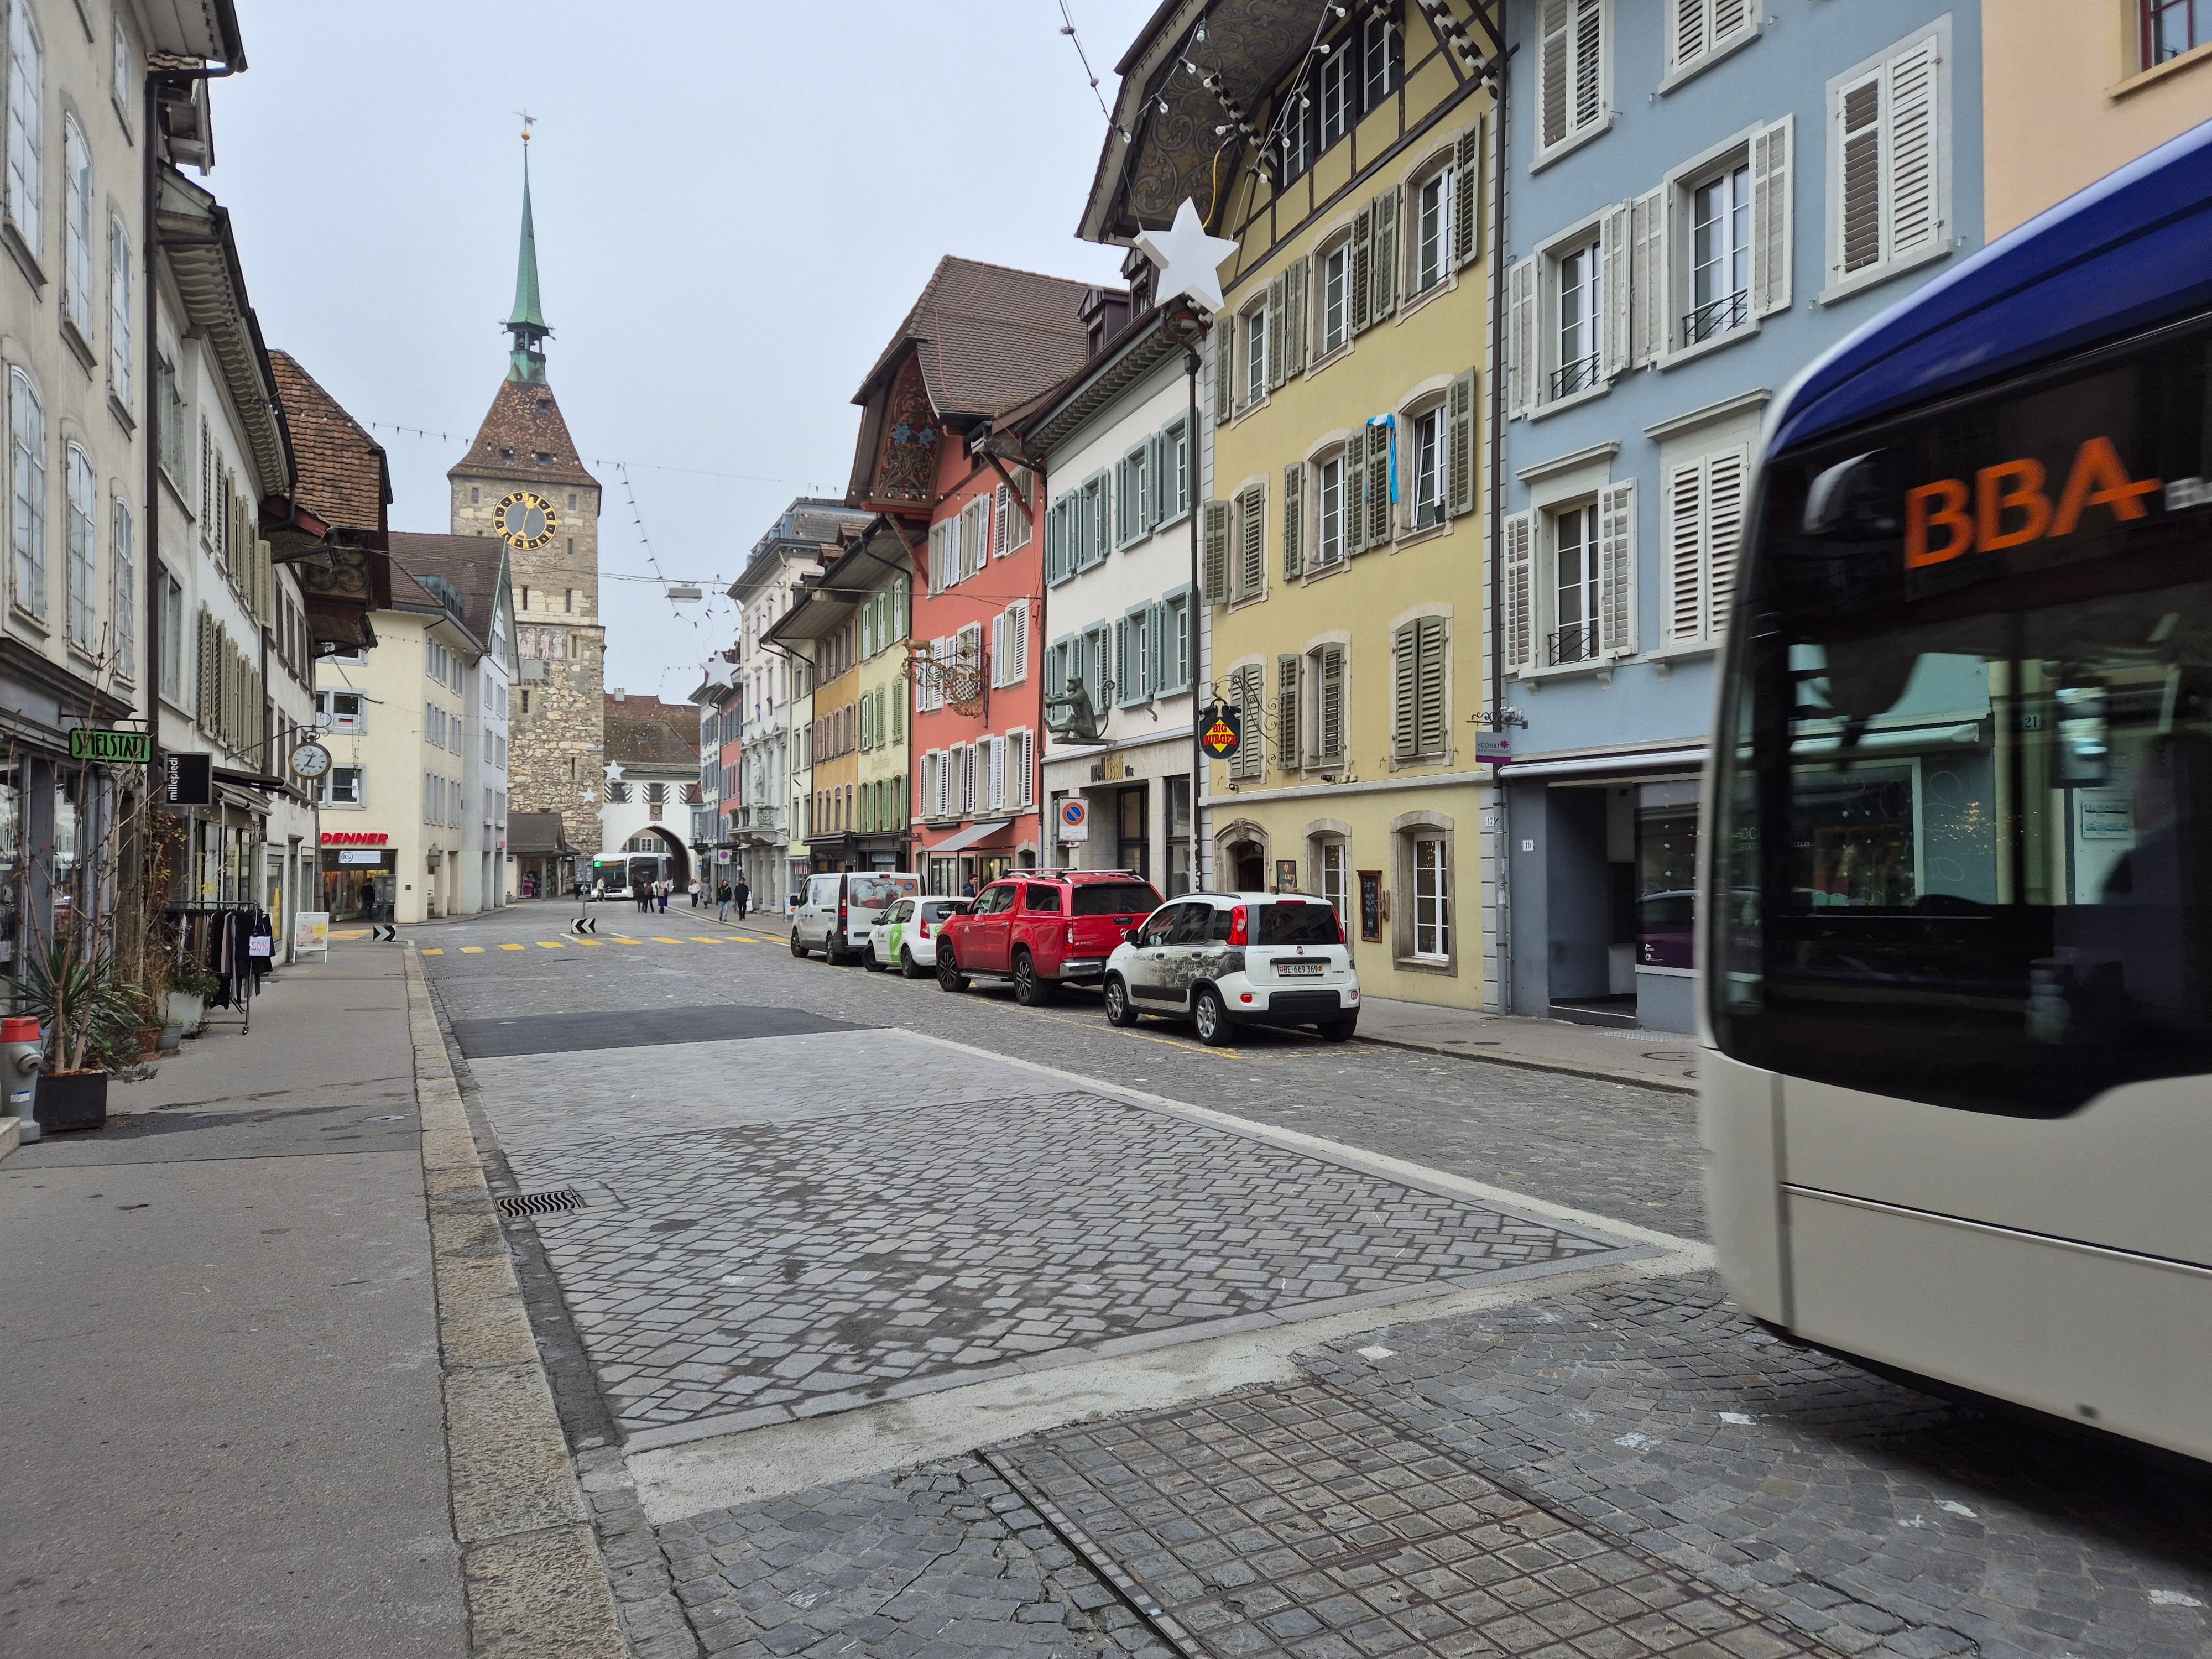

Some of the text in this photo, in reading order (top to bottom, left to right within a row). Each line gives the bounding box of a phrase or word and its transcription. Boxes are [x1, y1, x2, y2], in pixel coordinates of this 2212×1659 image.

[1903, 436, 2164, 570] BBA
[1213, 723, 1227, 733] BIG
[2025, 716, 2037, 728] 21
[1203, 734, 1237, 747] BURGER
[168, 757, 180, 800] millepiedi
[321, 832, 389, 845] DENNER
[1525, 842, 1531, 850] 19
[252, 942, 268, 951] 50%
